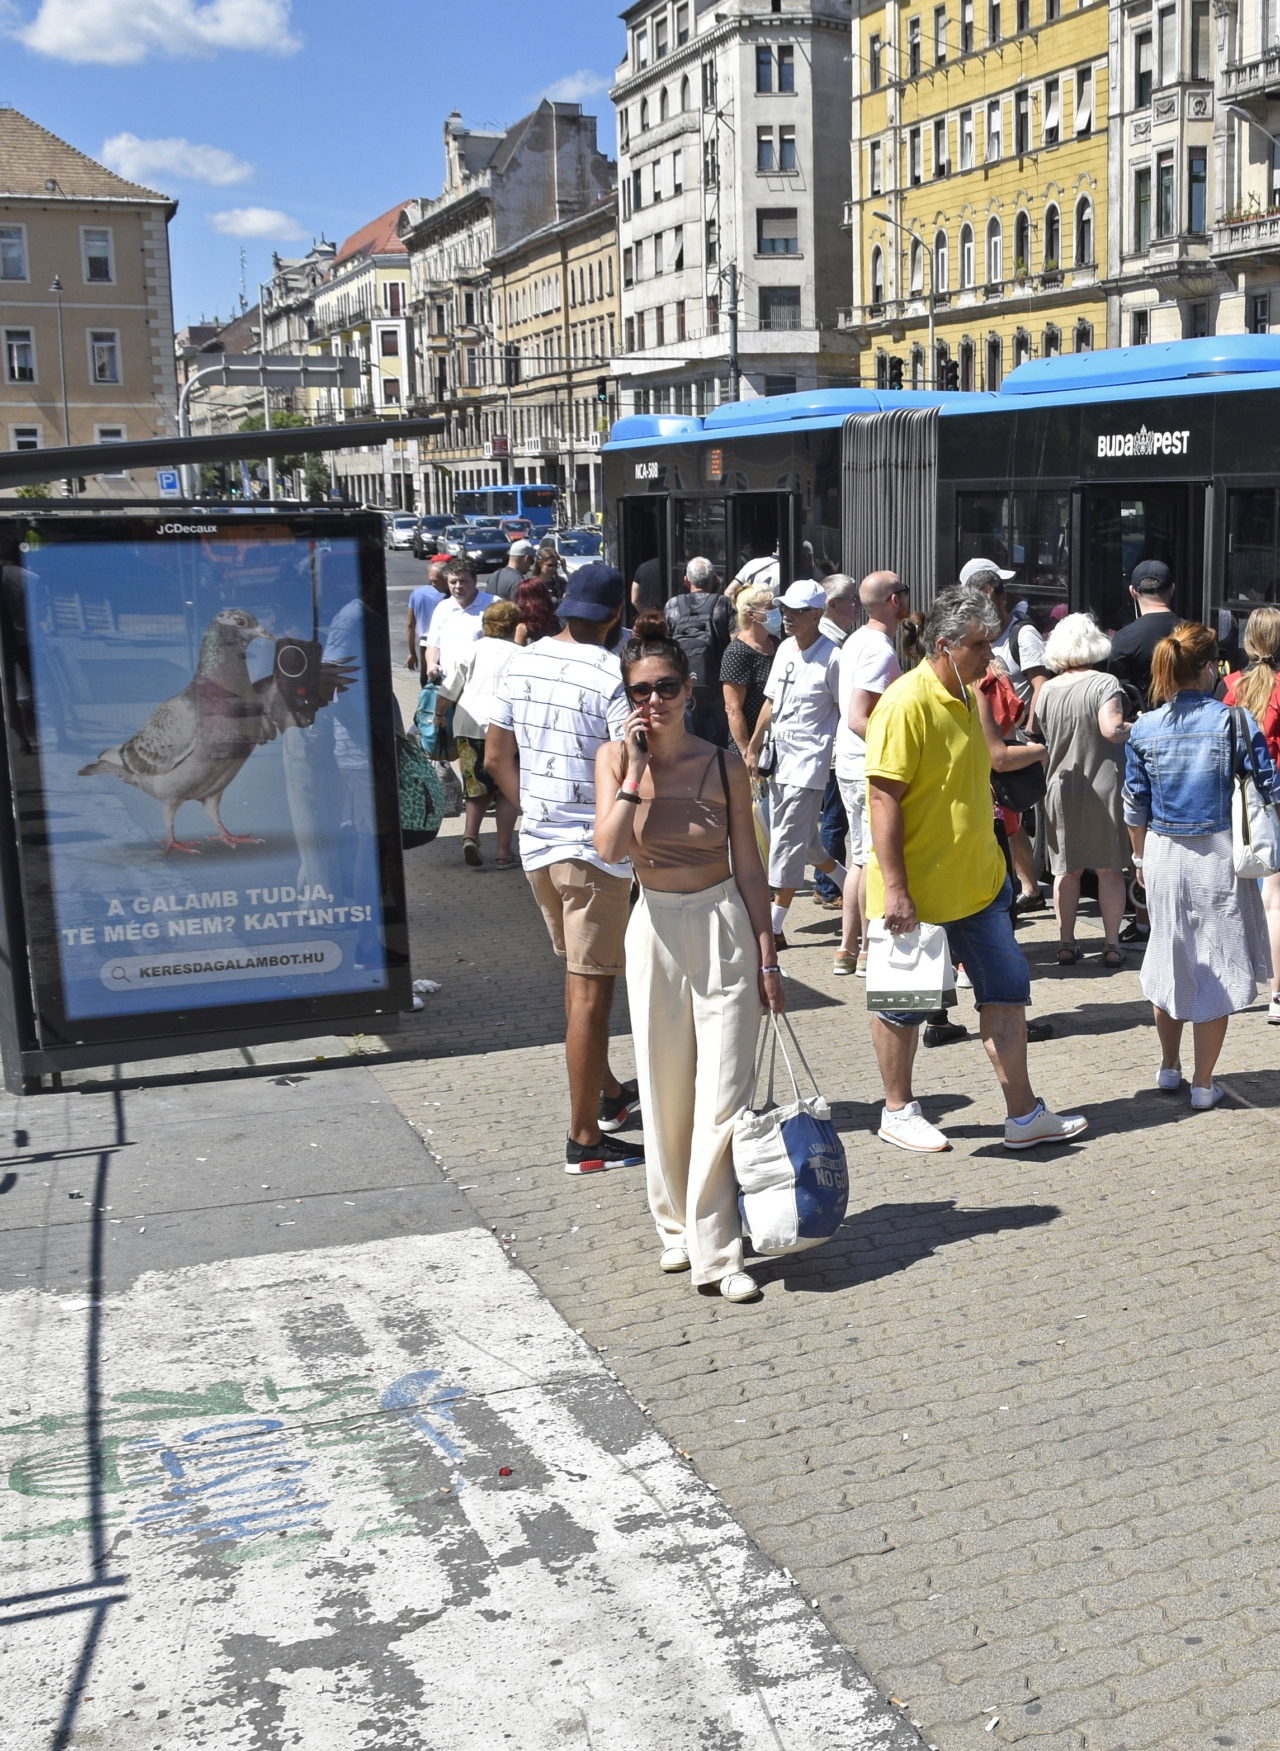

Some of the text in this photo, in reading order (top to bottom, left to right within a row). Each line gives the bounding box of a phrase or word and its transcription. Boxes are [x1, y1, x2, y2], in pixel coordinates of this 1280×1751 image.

[1097, 430, 1190, 457] BUDAPEST
[161, 474, 174, 489] P
[635, 462, 659, 479] NCA-508
[156, 523, 218, 535] JCDecaux
[107, 884, 334, 917] A GALAMB TUDJA,
[61, 905, 372, 946] TE MÉG NEM? KATTINTS!
[139, 951, 325, 979] KERESDAGALAMBOT.HU
